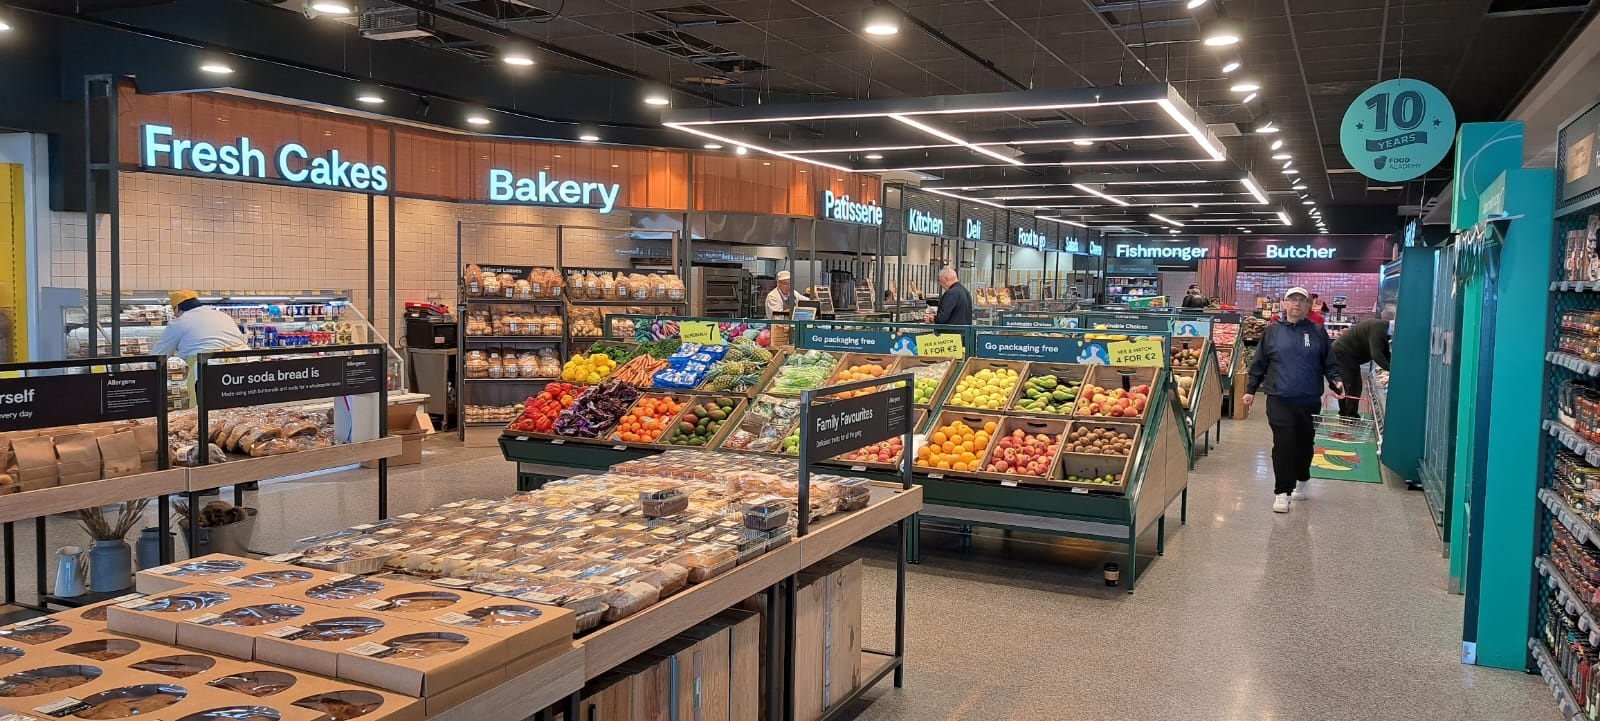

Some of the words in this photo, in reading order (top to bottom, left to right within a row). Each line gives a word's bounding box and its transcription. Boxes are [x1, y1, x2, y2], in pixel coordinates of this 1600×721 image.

[1365, 90, 1426, 132] 10
[1378, 134, 1416, 150] YEARS
[142, 123, 265, 178] Fresh
[279, 143, 388, 192] Cakes
[489, 169, 620, 213] Bakery
[824, 190, 883, 226] Patisserie
[909, 208, 944, 236] Kitchen
[966, 219, 981, 239] Deli
[1018, 228, 1033, 246] Food
[1033, 231, 1039, 246] to
[1039, 235, 1046, 251] go
[1116, 244, 1208, 260] Fishmonger
[1266, 244, 1336, 259] Butcher
[812, 334, 823, 343] Go
[824, 336, 859, 345] packaging
[861, 337, 876, 345] free
[985, 342, 997, 350] Go
[999, 343, 1040, 353] packaging
[1042, 344, 1059, 353] free
[930, 346, 945, 355] FOR
[947, 345, 958, 353] €2
[1124, 355, 1142, 363] FOR
[1144, 353, 1157, 361] €2
[222, 374, 245, 386] Our
[247, 371, 276, 384] soda
[278, 367, 309, 381] bread
[311, 367, 320, 378] is
[19, 410, 33, 418] day
[816, 414, 840, 433] Family
[840, 407, 873, 427] Favourites
